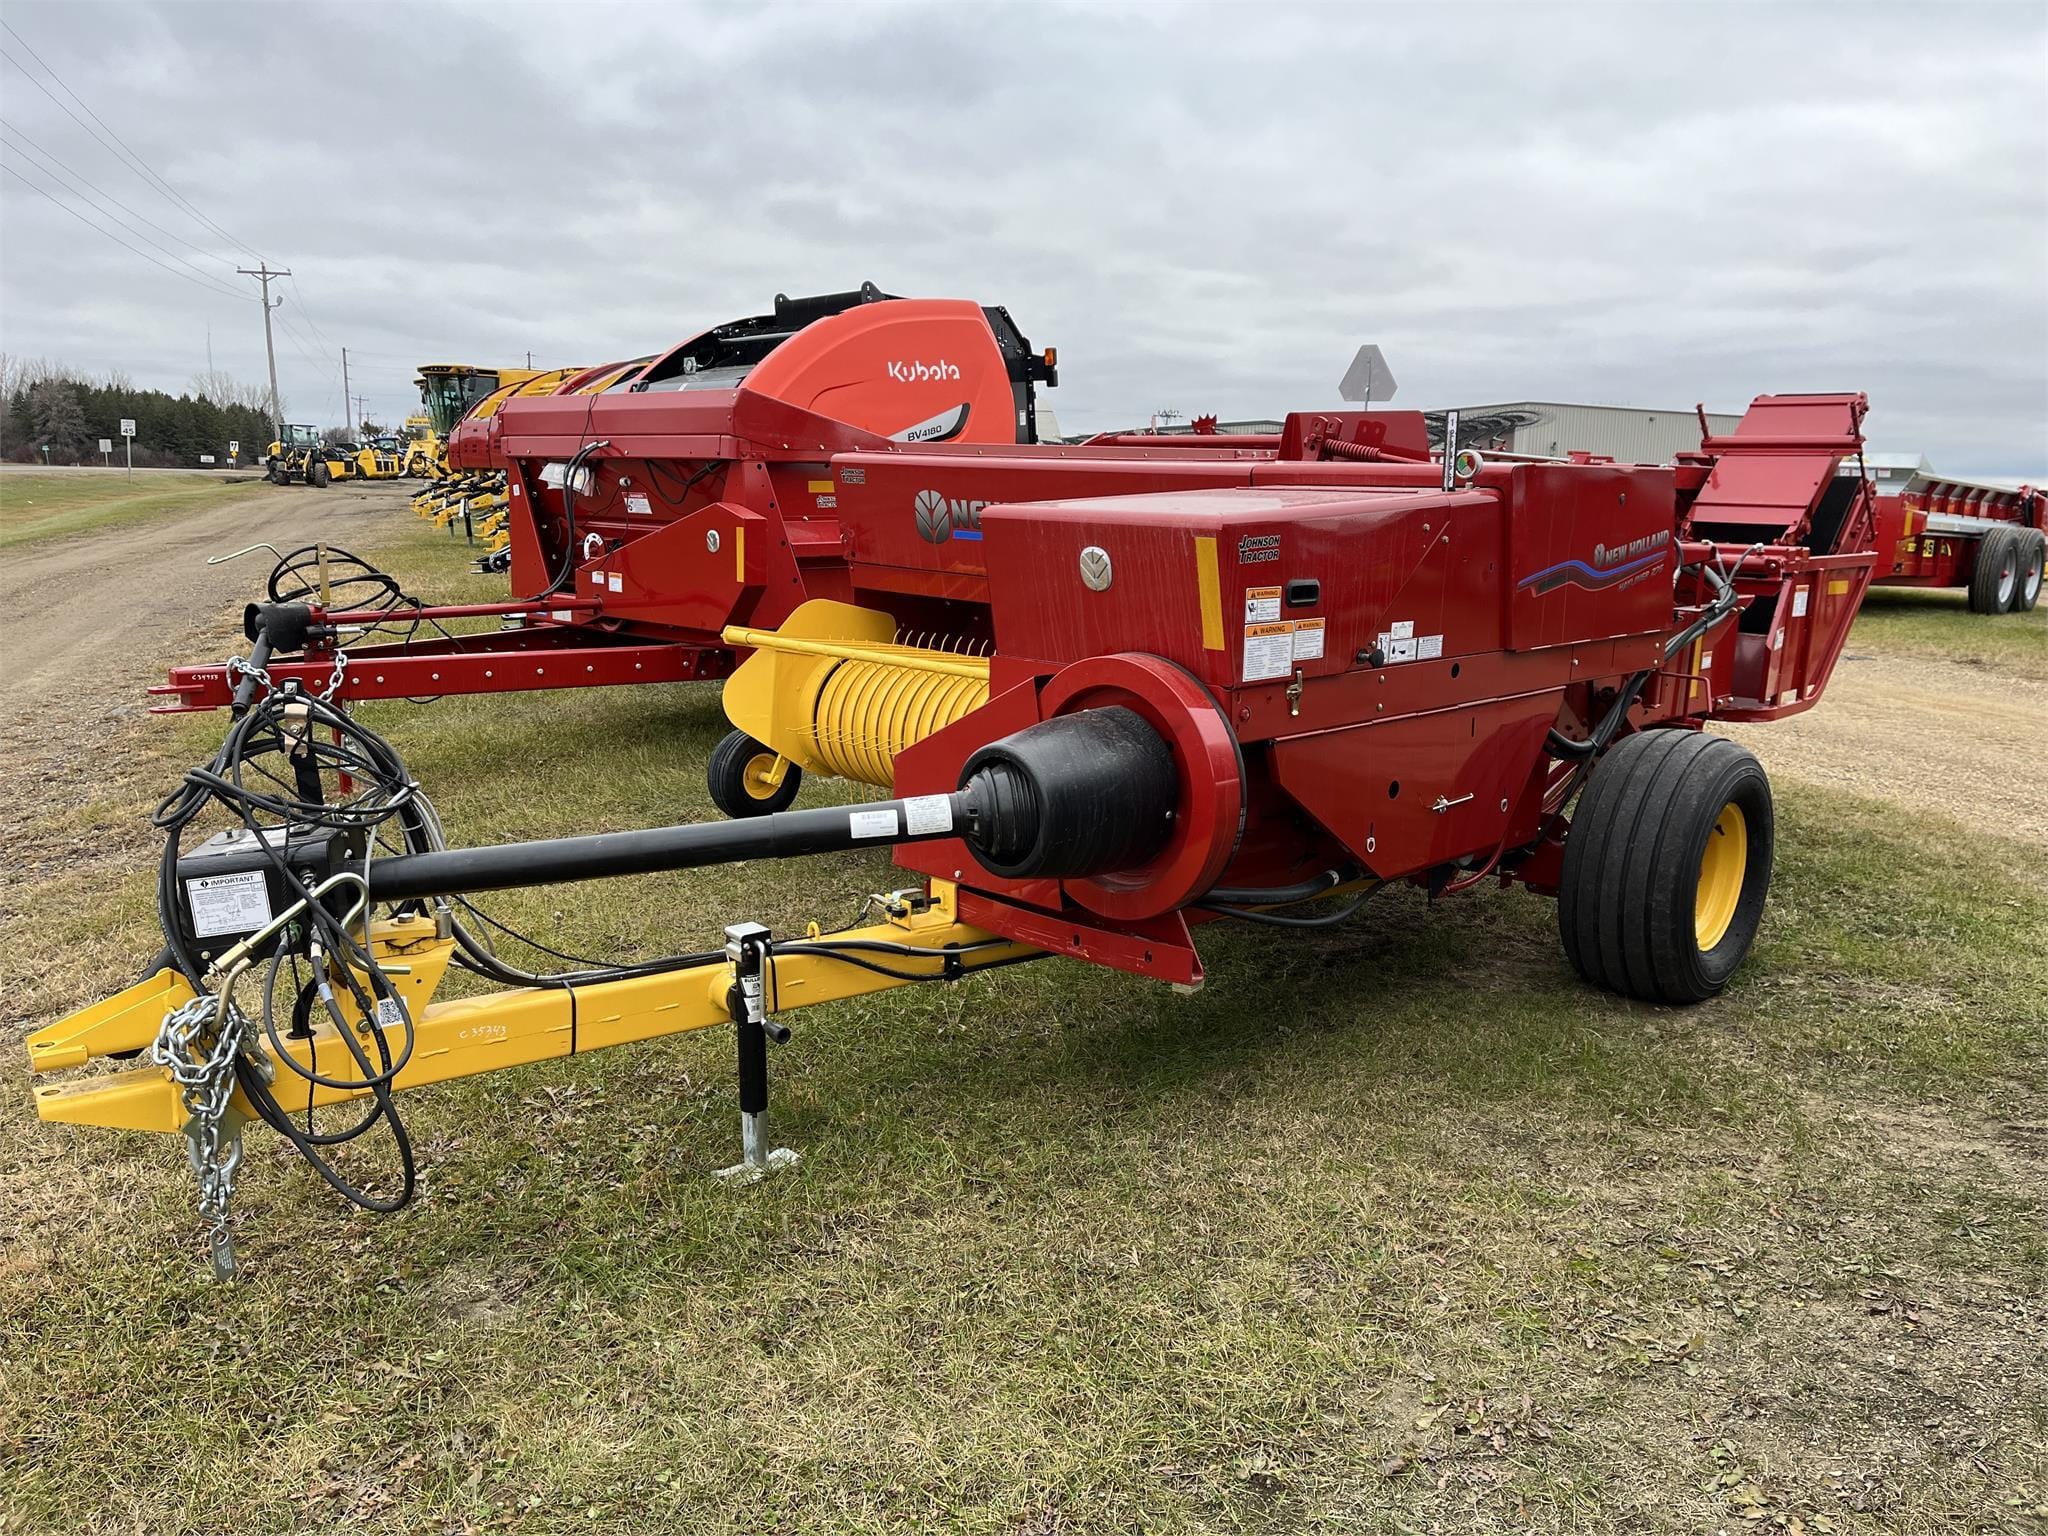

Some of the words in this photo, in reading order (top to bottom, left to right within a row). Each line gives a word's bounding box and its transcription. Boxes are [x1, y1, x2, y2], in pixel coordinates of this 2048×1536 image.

[887, 359, 961, 382] Kubota
[907, 425, 942, 441] BV4180
[950, 499, 996, 528] NE
[1239, 535, 1280, 549] JOHNSON
[1605, 545, 1628, 565] NEW
[1628, 529, 1670, 555] HOLLAND
[1239, 549, 1280, 564] TRACTOR
[1260, 625, 1286, 634] WARNING
[210, 875, 254, 886] IMPORTANT
